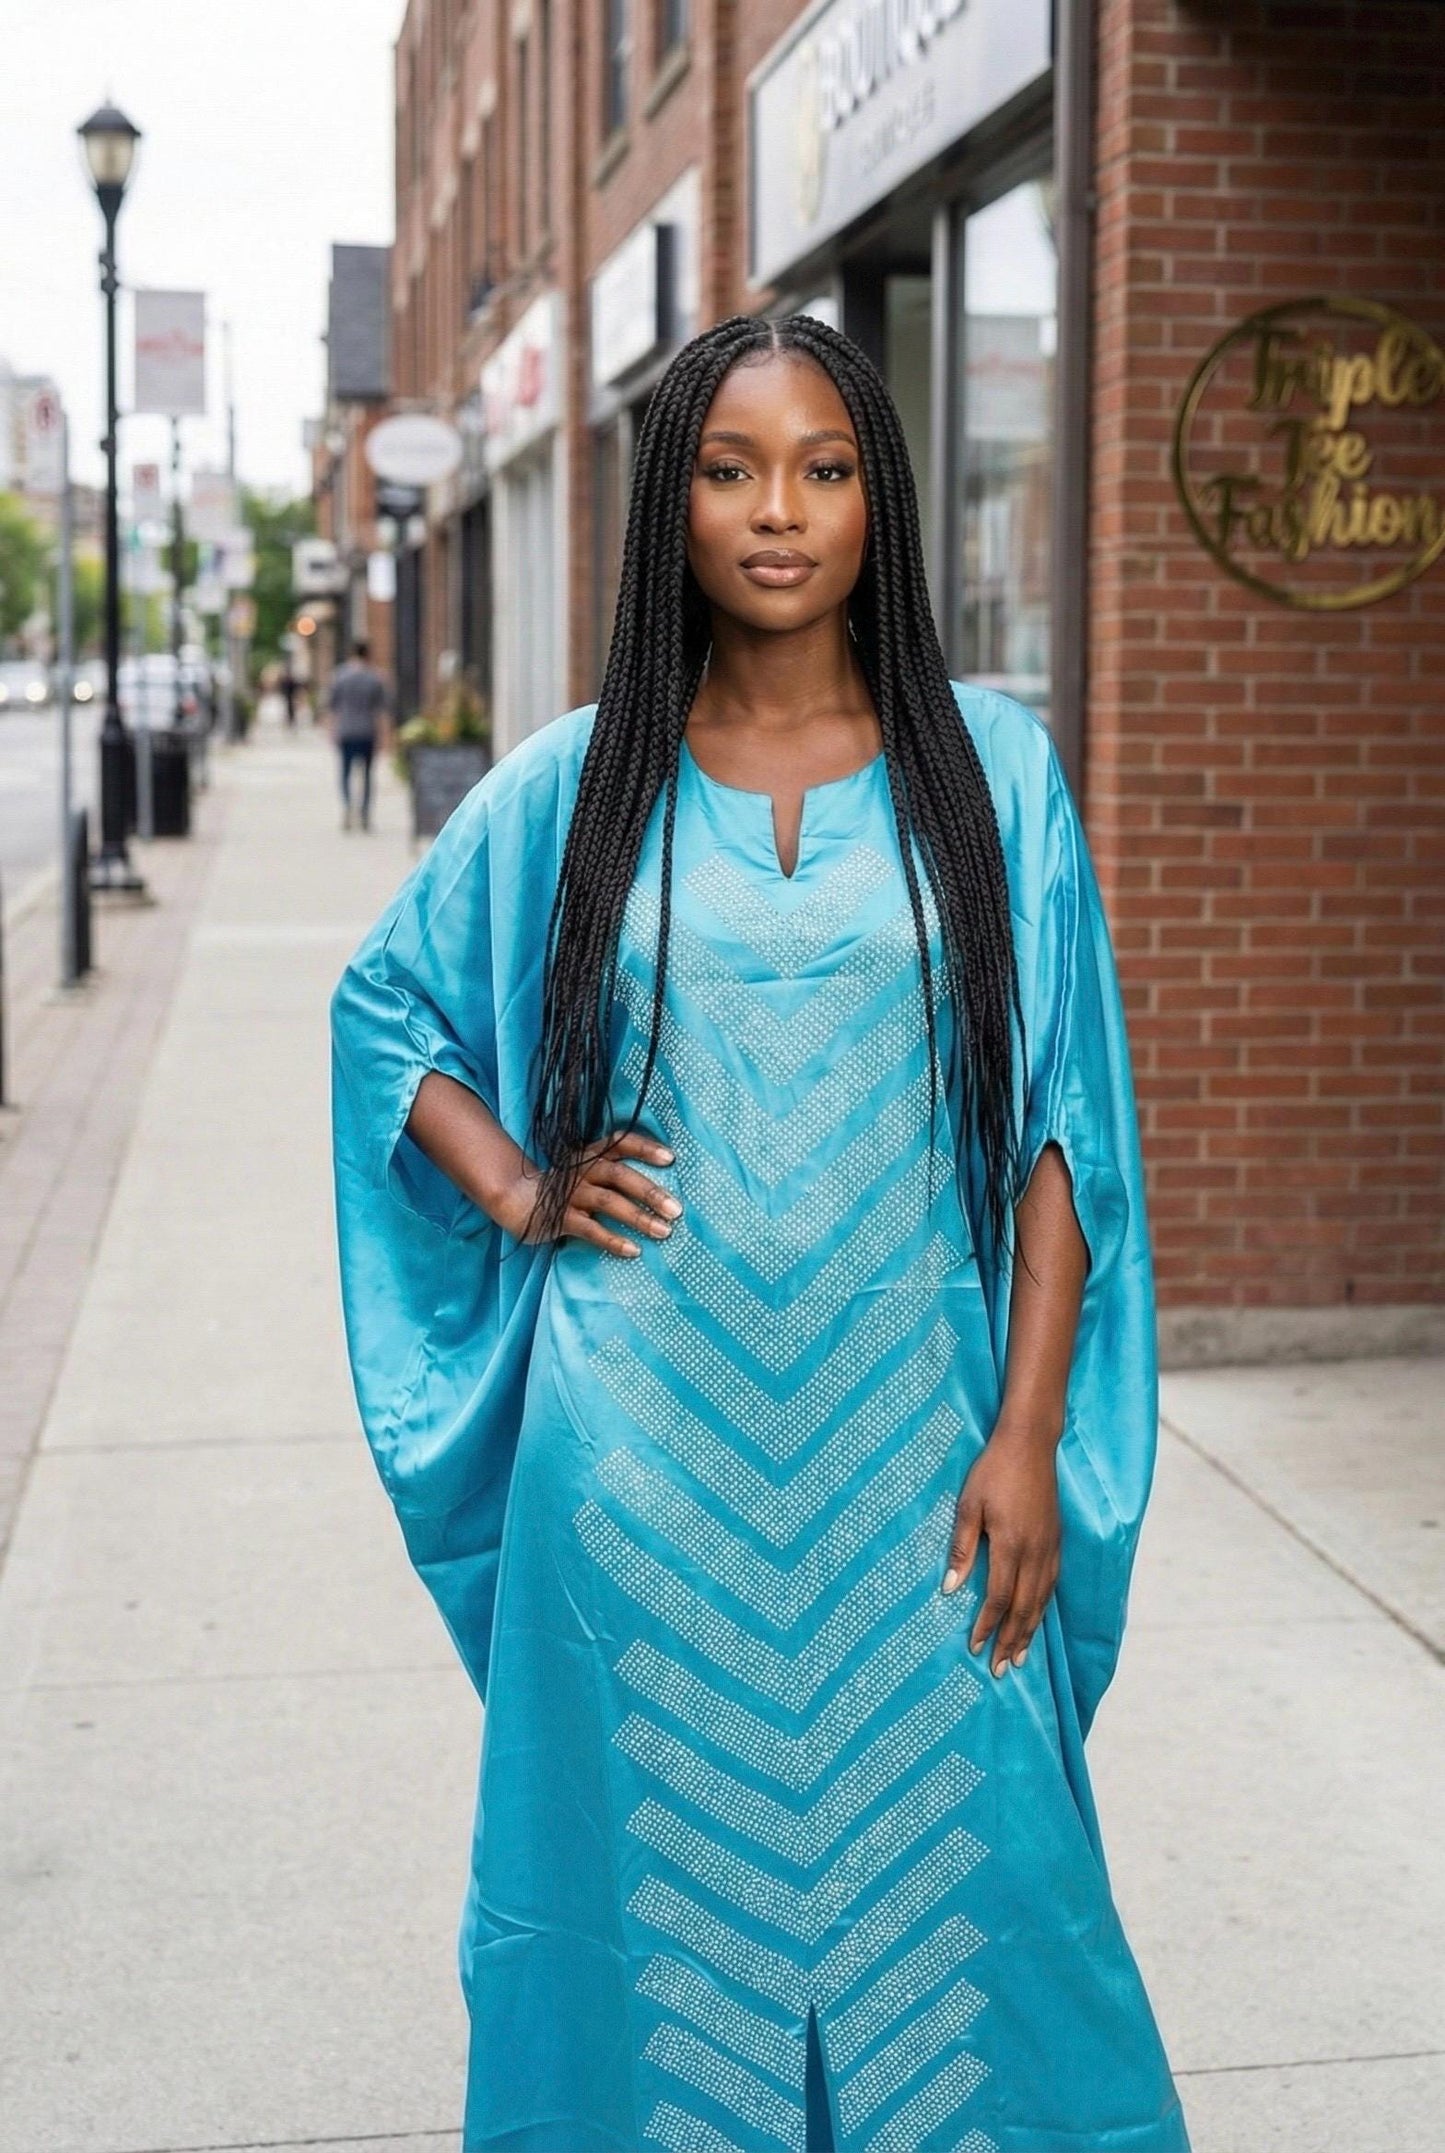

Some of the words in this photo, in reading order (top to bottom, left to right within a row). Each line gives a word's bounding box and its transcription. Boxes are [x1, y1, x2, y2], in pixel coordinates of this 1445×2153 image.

[1249, 320, 1445, 430] Triple
[1268, 419, 1371, 489] Tee
[1199, 473, 1441, 561] Fashion
